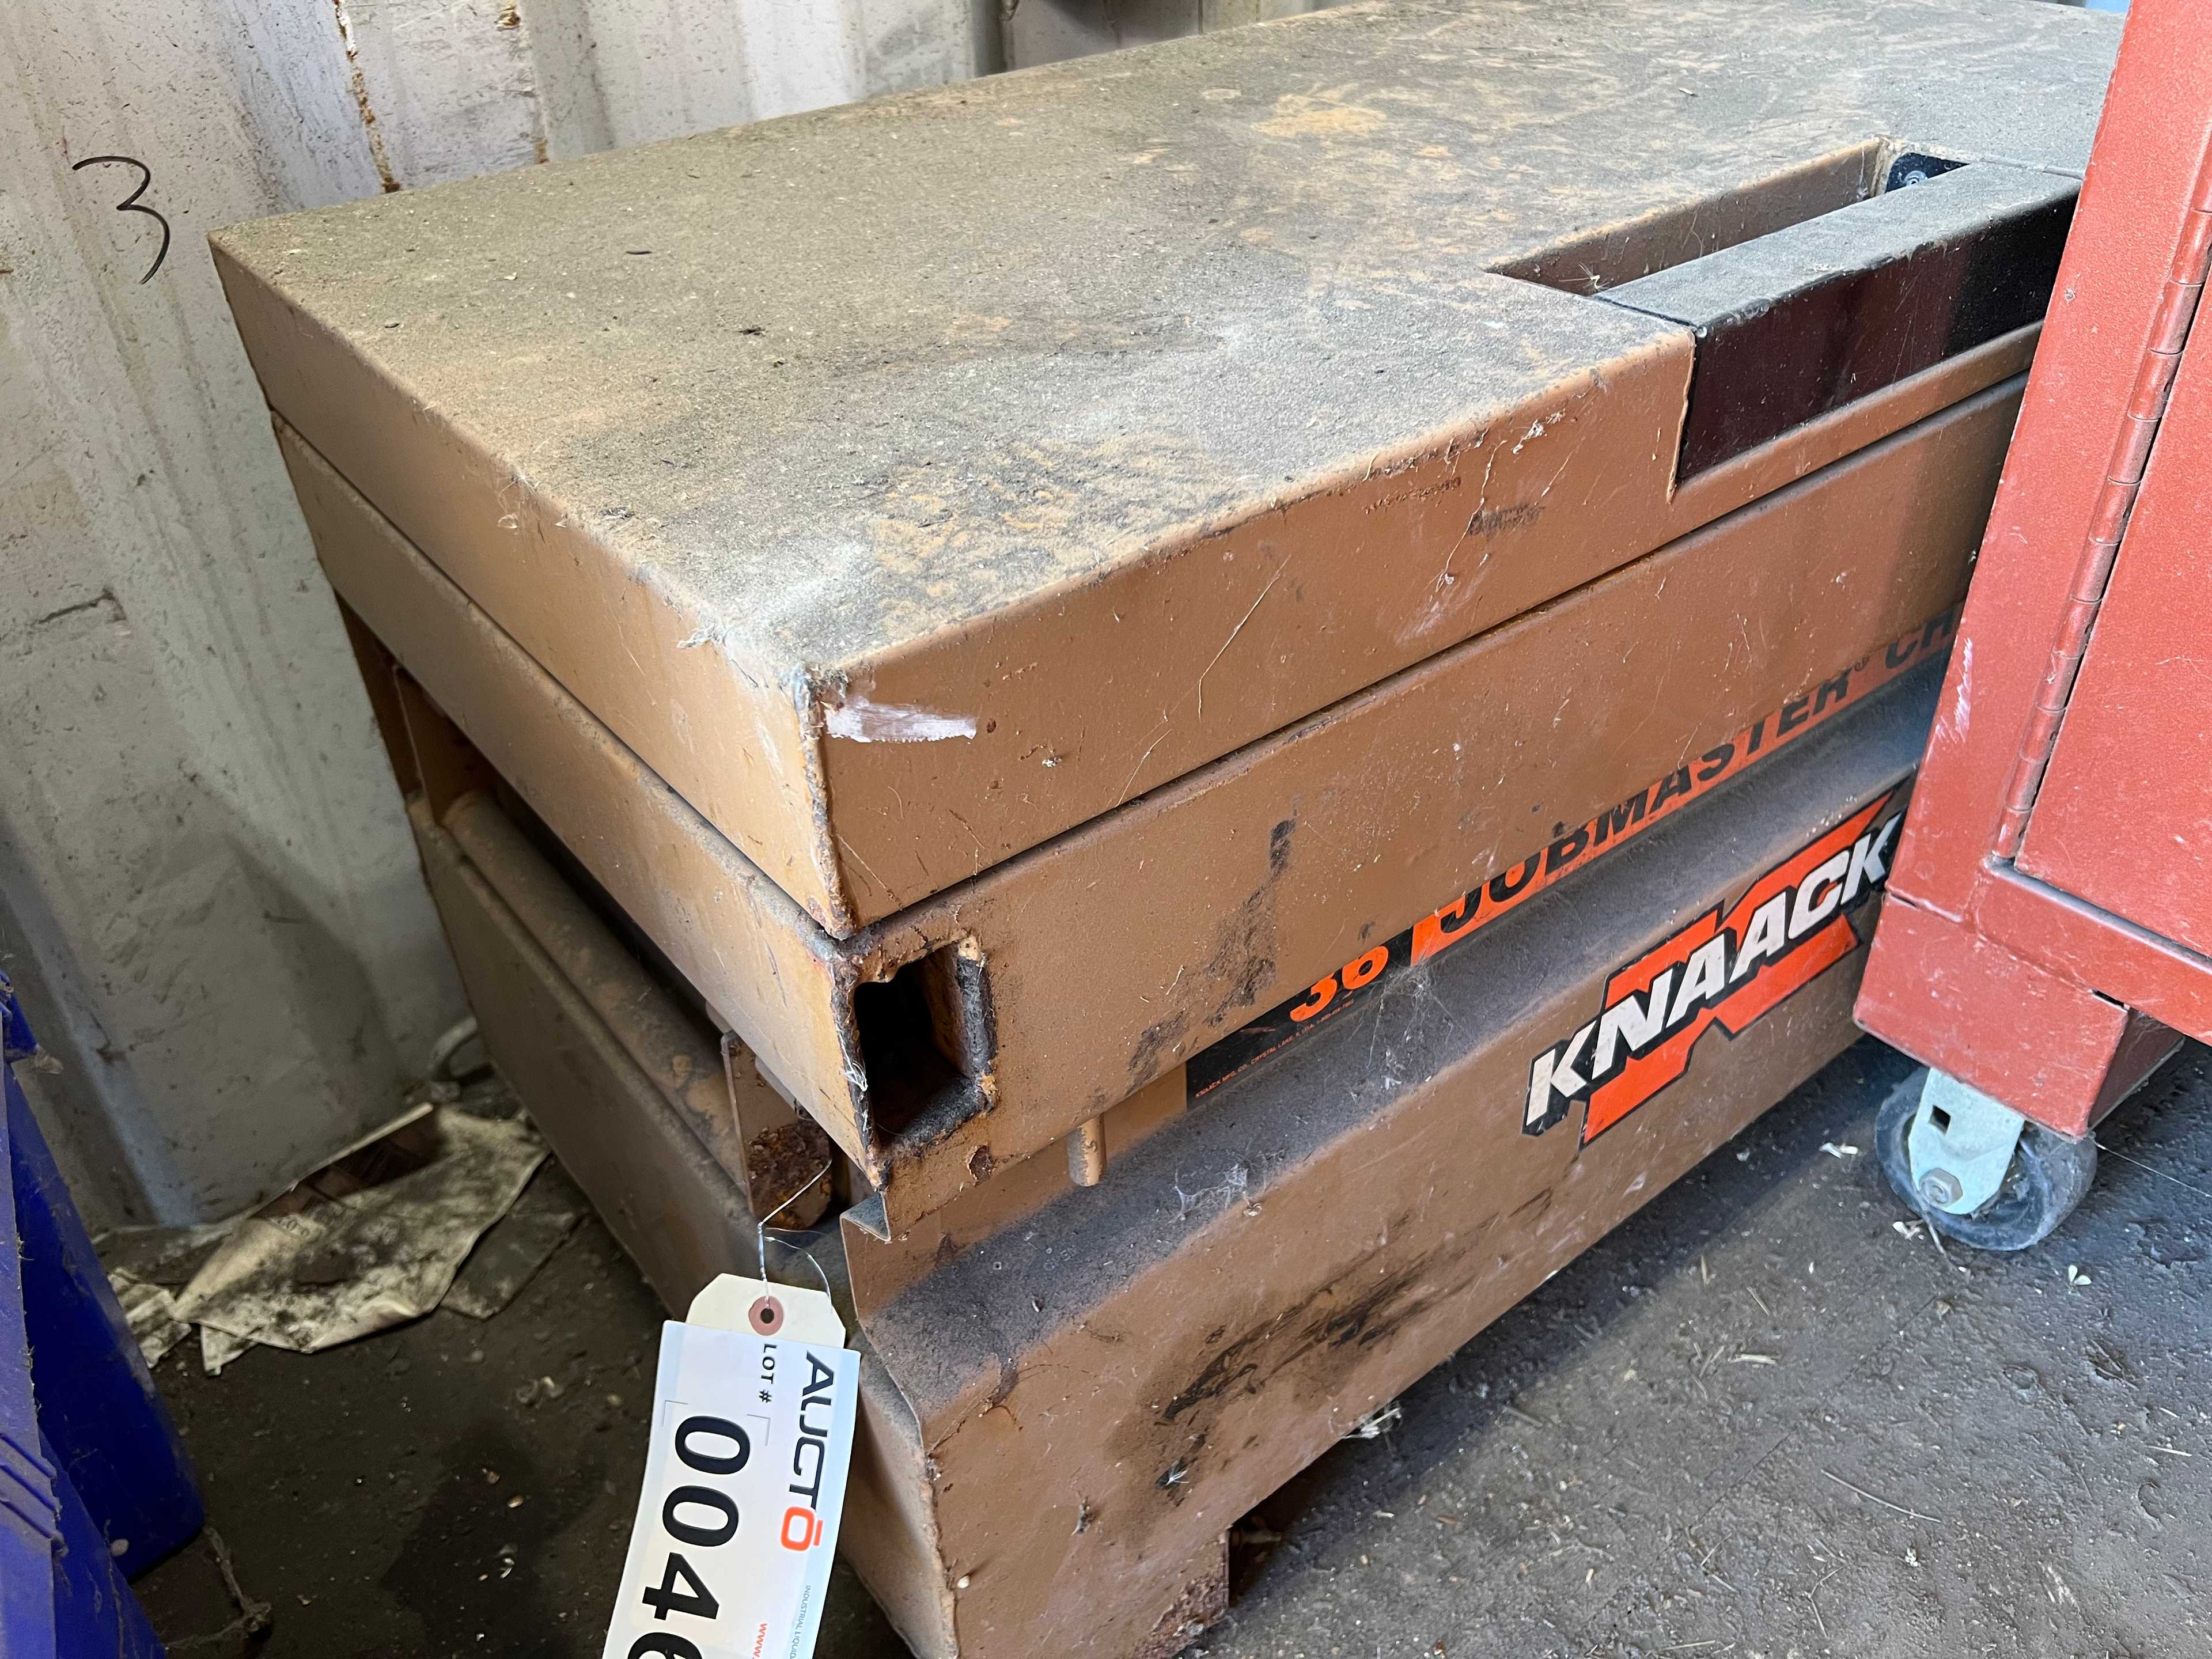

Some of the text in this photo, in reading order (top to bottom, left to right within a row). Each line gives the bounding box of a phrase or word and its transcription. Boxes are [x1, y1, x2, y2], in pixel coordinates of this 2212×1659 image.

[72, 156, 170, 285] 3
[1526, 811, 1902, 1126] KNAACK
[761, 1343, 777, 1384] LOT
[790, 1585, 811, 1659] INDUSTRIAL LIQUID
